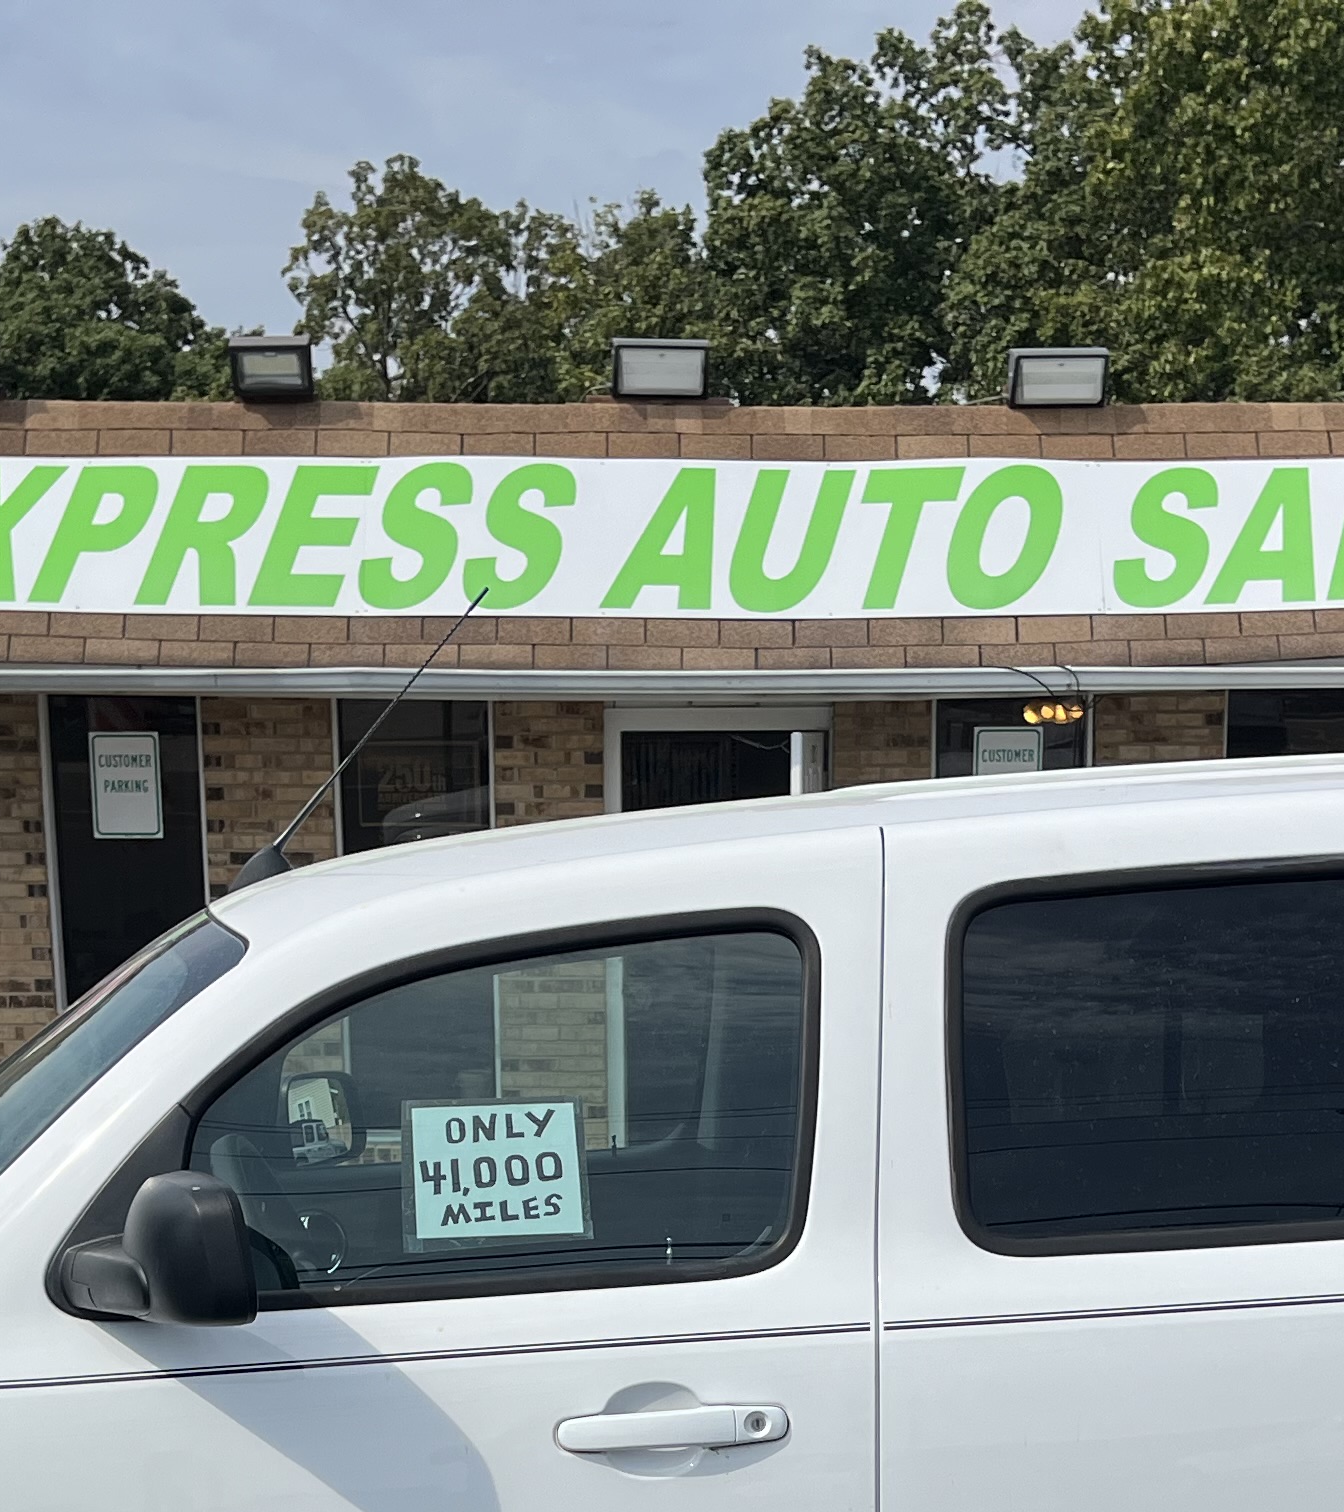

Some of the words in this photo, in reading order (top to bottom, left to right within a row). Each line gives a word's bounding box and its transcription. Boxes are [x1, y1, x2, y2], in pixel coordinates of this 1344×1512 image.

[601, 464, 1063, 612] AUTO
[98, 754, 153, 768] CUSTOMER
[981, 748, 1035, 763] CUSTOMER
[104, 779, 150, 793] PARKING
[445, 1108, 556, 1144] ONLY
[419, 1151, 564, 1197] 41,000
[440, 1193, 563, 1227] MILES
